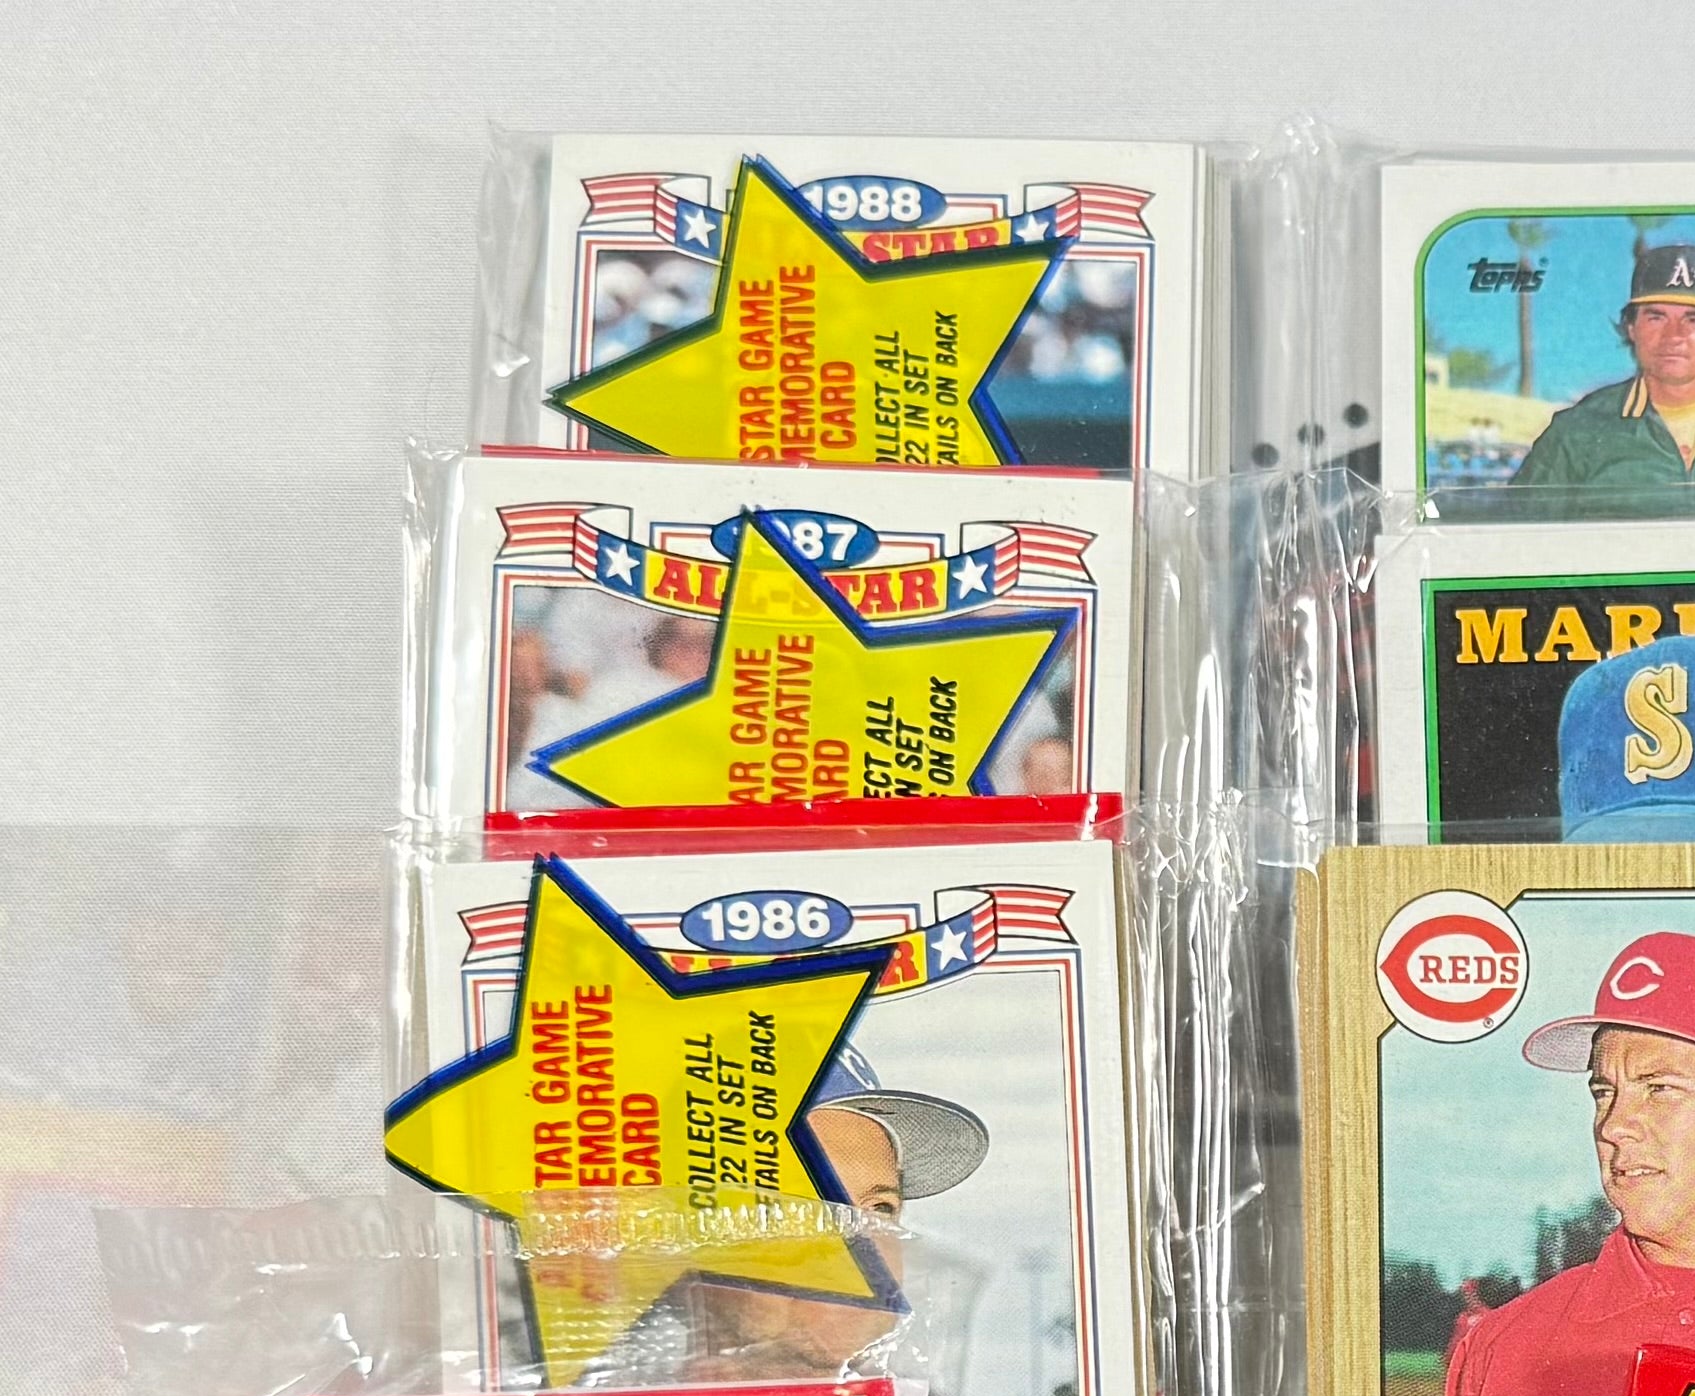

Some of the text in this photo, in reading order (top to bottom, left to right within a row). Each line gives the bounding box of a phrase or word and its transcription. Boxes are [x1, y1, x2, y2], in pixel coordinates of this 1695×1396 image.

[803, 184, 922, 223] 1988
[739, 280, 775, 371] GAME
[874, 330, 900, 375] ALL
[934, 310, 959, 408] ON BACK
[820, 361, 856, 450] CARD
[903, 349, 930, 432] IN SET
[730, 648, 772, 745] GAME
[865, 695, 895, 748] ALL
[928, 675, 959, 787] ON BACK
[1623, 663, 1695, 784] S
[893, 717, 925, 773] SET
[701, 898, 832, 942] 1986
[1419, 955, 1520, 985] REDS
[1610, 956, 1665, 1000] C
[532, 1000, 572, 1106] GAME
[684, 1032, 715, 1094] ALL
[750, 1010, 780, 1123] ON BACK
[622, 1092, 662, 1190] CARD
[717, 1055, 747, 1148] IN SET
